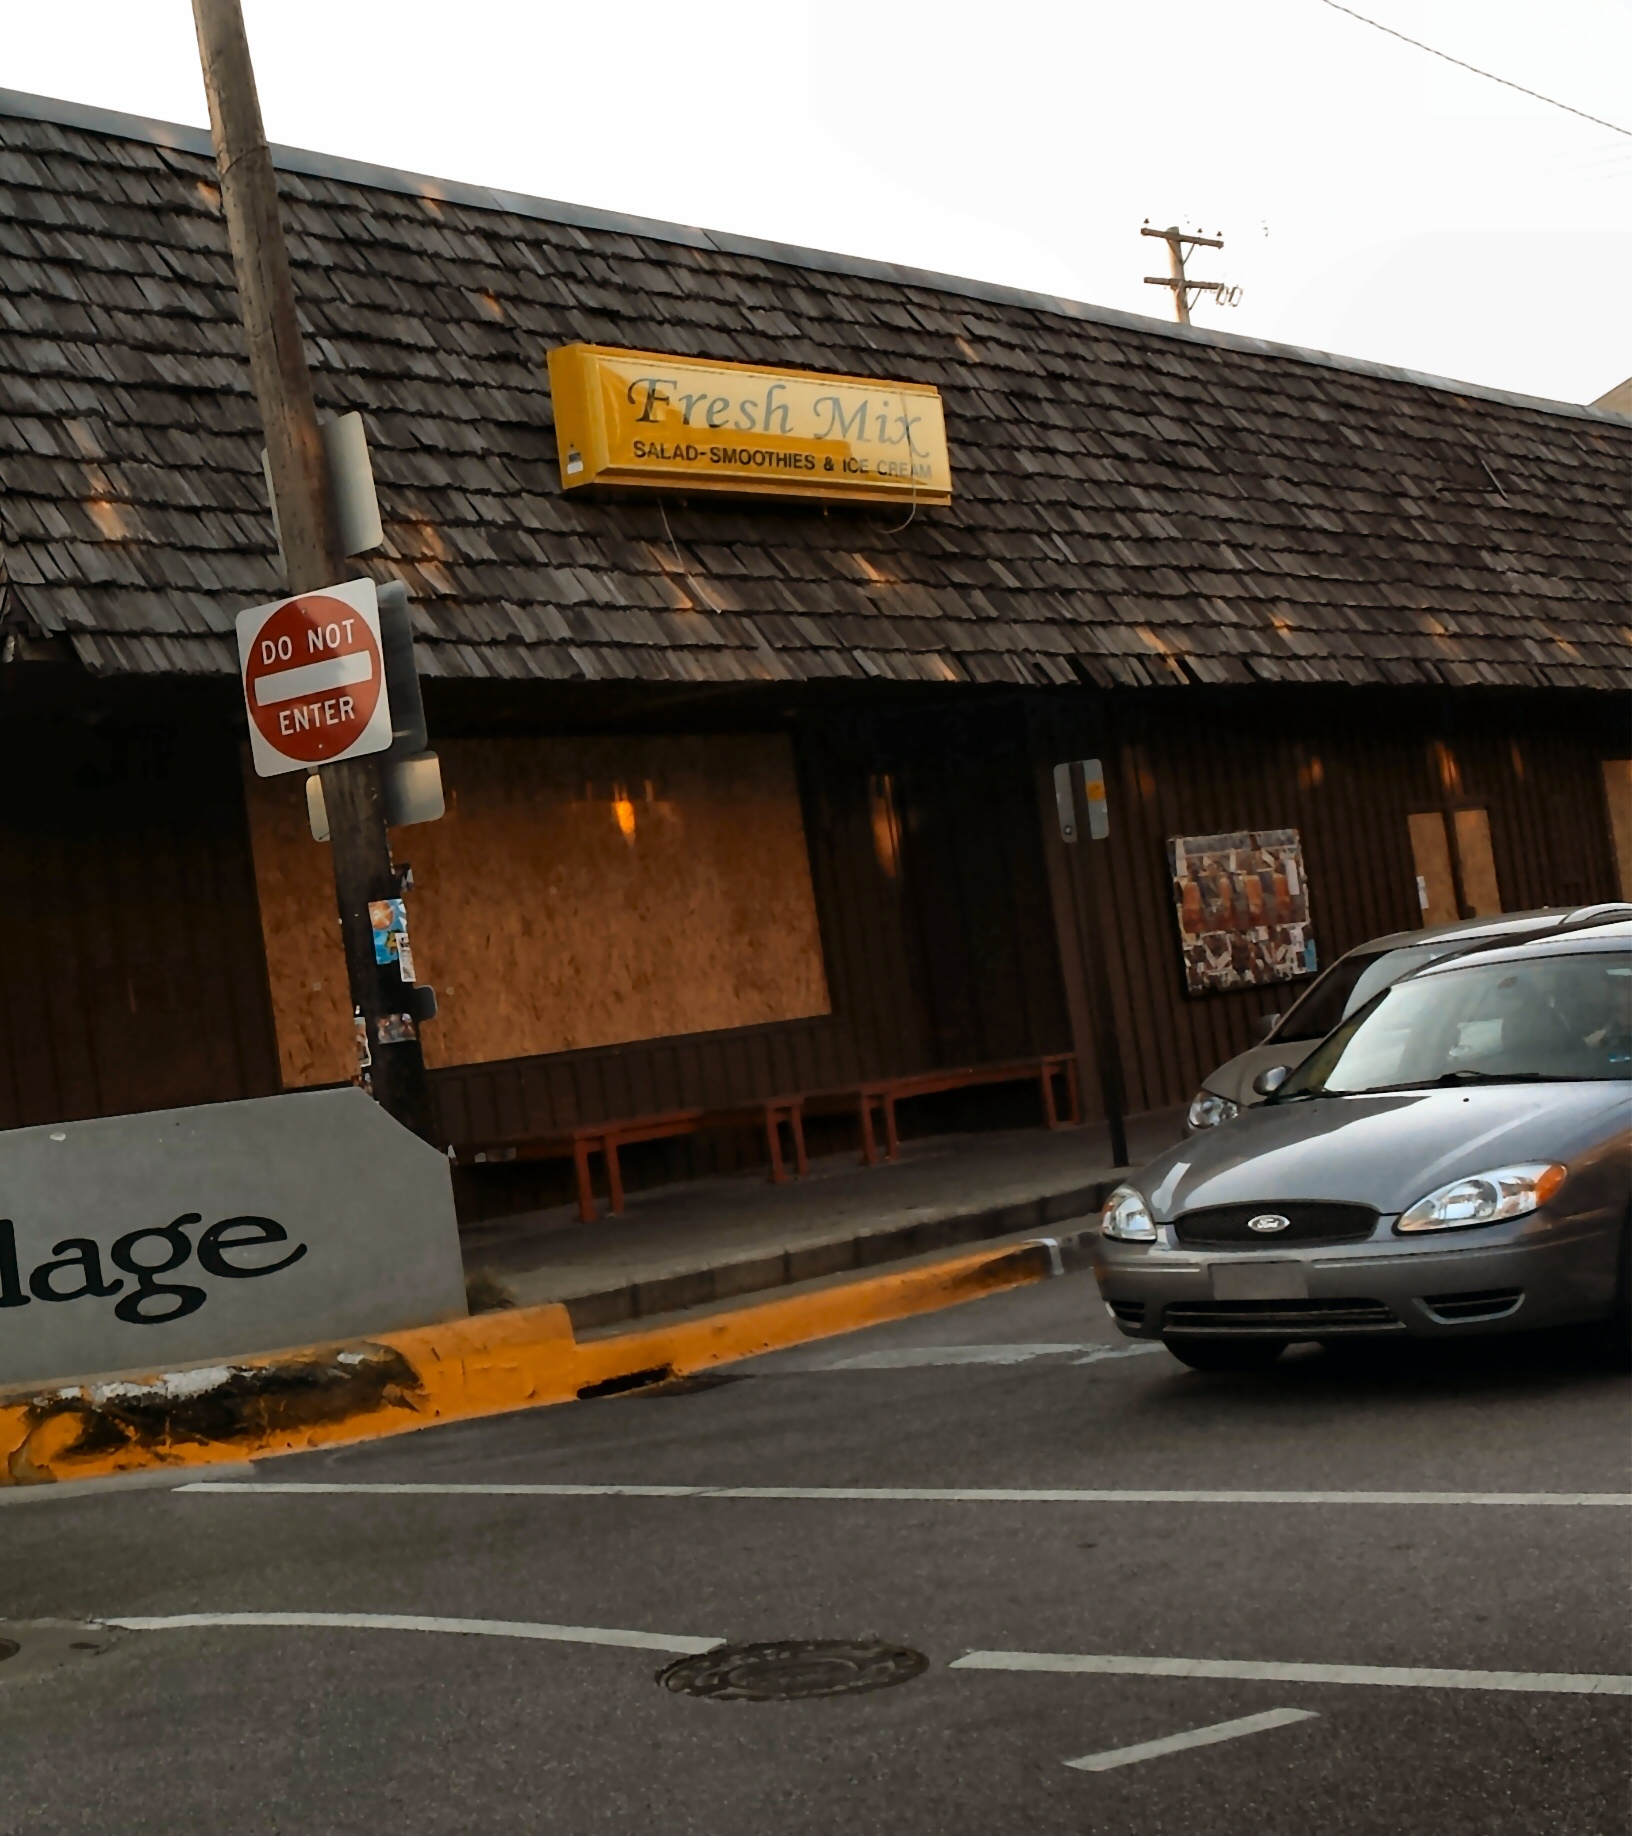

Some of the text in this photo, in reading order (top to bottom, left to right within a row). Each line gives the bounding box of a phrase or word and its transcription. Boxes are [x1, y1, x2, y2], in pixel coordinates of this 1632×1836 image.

[627, 378, 930, 458] Fresh Mix
[633, 440, 932, 479] SALAD-SMOOTHIES & ICE CREAM
[261, 618, 355, 665] DO NOT
[279, 696, 355, 736] ENTER
